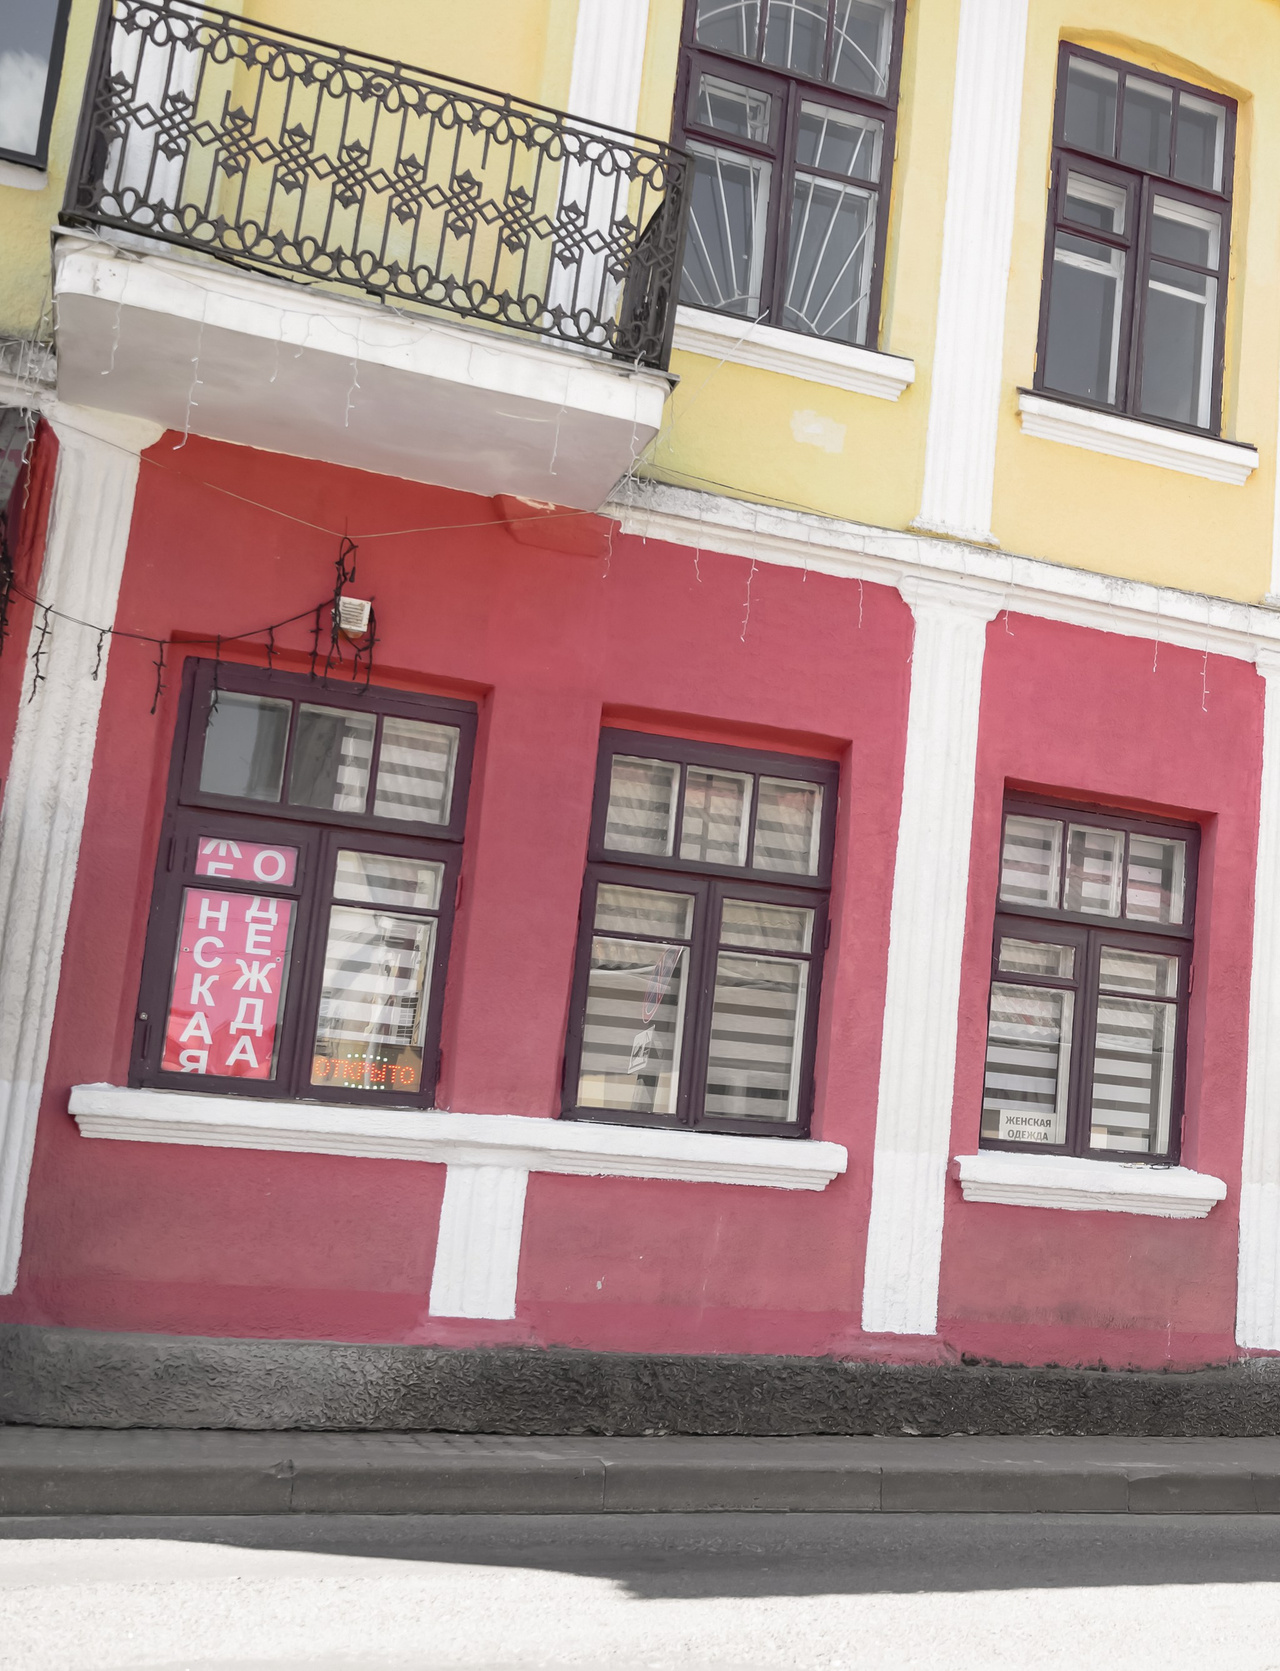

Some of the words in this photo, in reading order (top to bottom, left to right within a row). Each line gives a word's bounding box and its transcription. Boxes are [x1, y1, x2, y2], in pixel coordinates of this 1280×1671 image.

[225, 850, 286, 1068] ОДЕЖДА
[315, 1058, 415, 1085] ОТКРЫТО
[1005, 1116, 1052, 1128] ЖЕНСКАЯ
[1007, 1129, 1049, 1141] ОДЕЖДА
